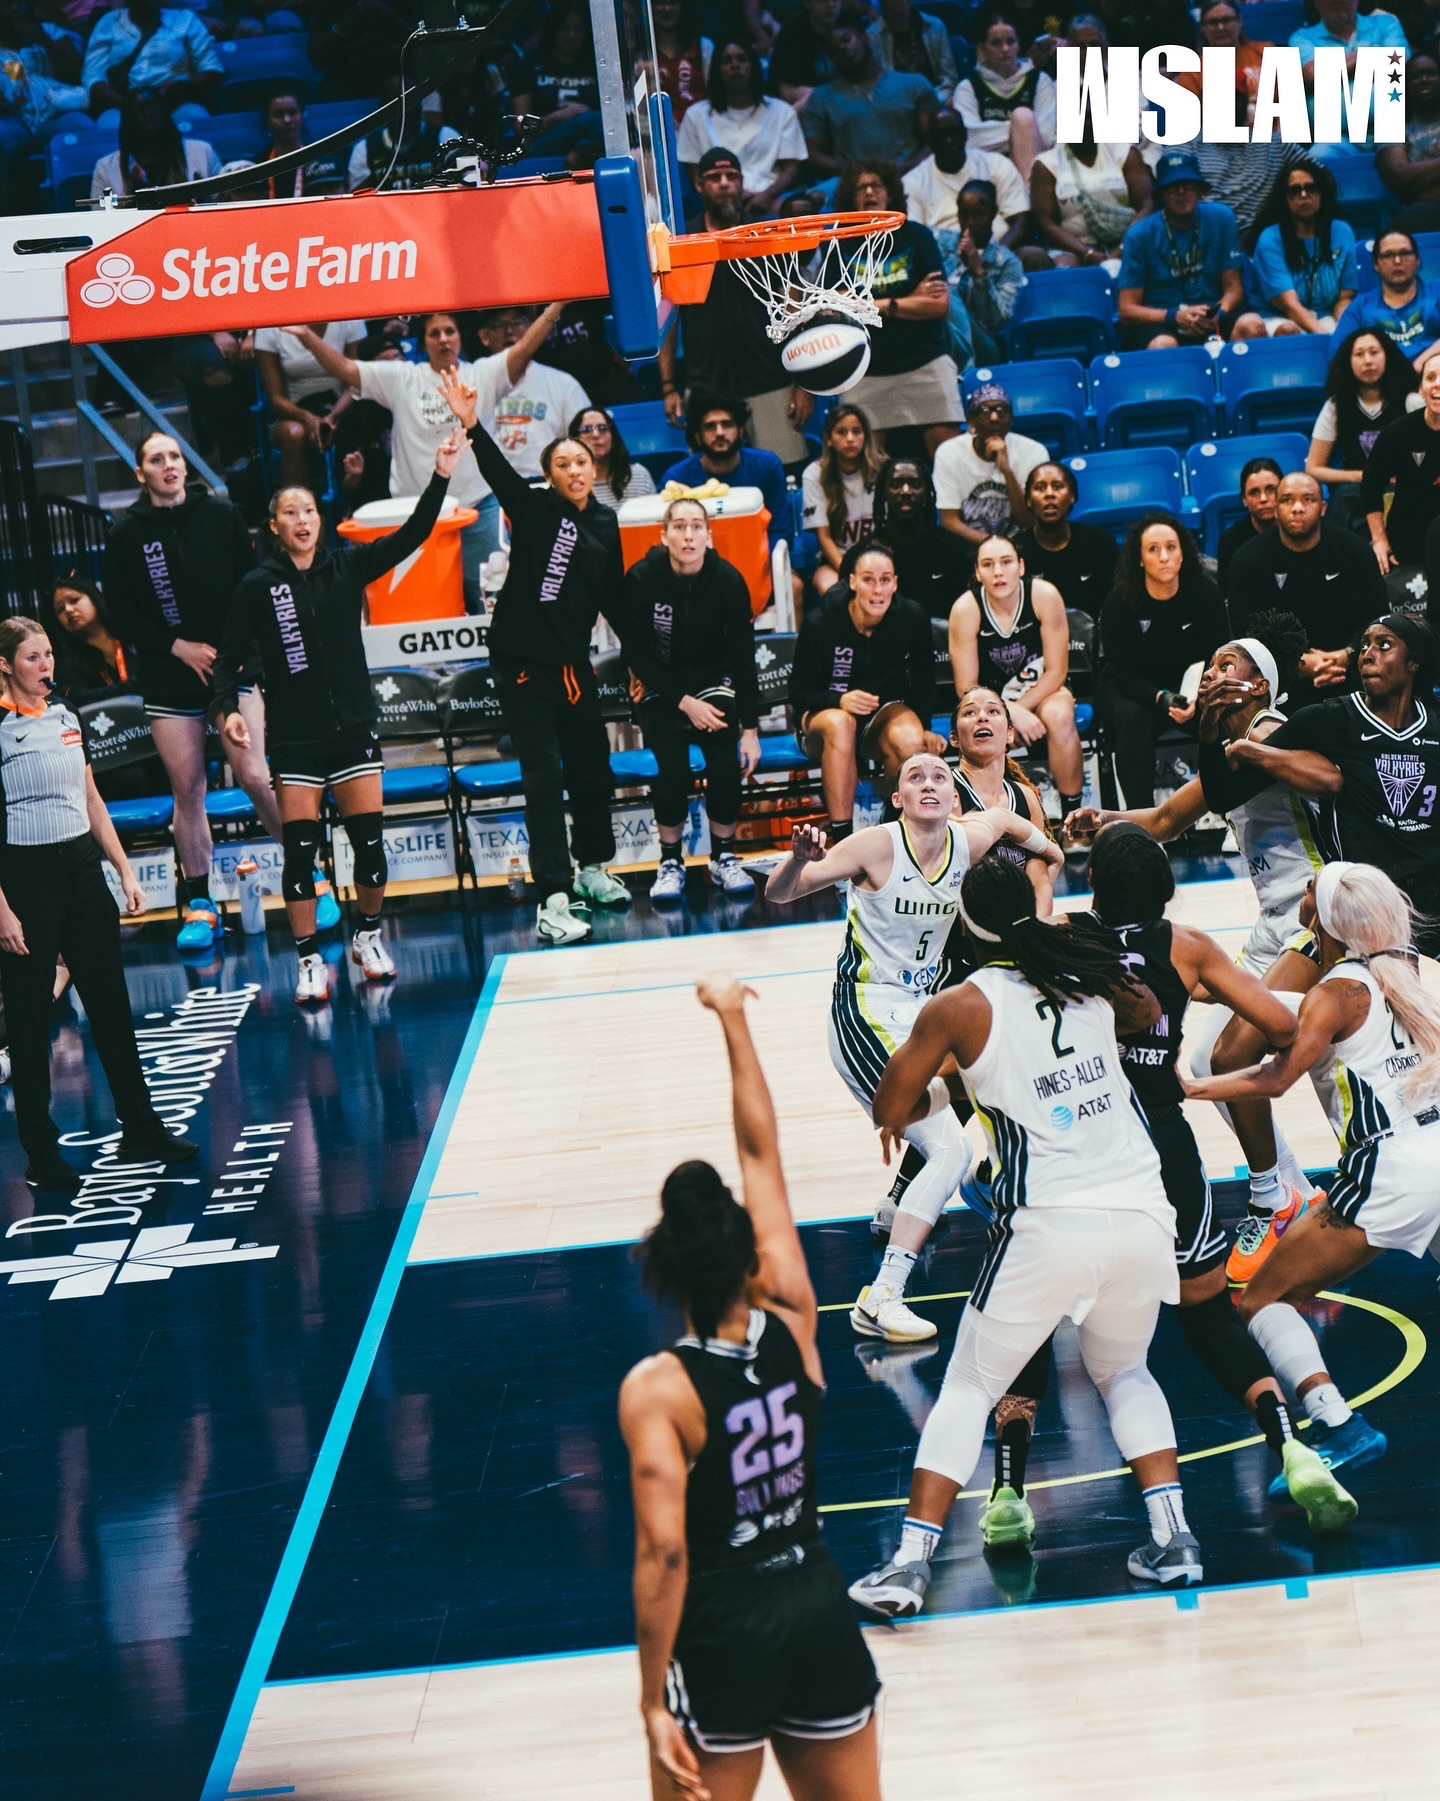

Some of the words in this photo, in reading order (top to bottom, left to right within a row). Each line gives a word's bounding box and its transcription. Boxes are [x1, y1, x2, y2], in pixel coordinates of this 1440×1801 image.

[786, 332, 842, 362] Wilson
[539, 517, 578, 602] VALKYRIES
[143, 541, 181, 627] VALKYRIES
[270, 583, 309, 674] VALKYRIES
[1374, 757, 1426, 778] VALKYRIES
[1403, 754, 1420, 762] STATE
[1417, 784, 1437, 817] 3
[401, 853, 448, 865] COMPANY
[915, 930, 934, 961] 5
[1035, 999, 1076, 1059] 2
[1125, 1047, 1169, 1066] AT&T
[1033, 1054, 1108, 1101] HINES-ALLEN
[1077, 1093, 1112, 1121] AT&T
[202, 1121, 294, 1216] HEALTH
[725, 1381, 805, 1486] 25
